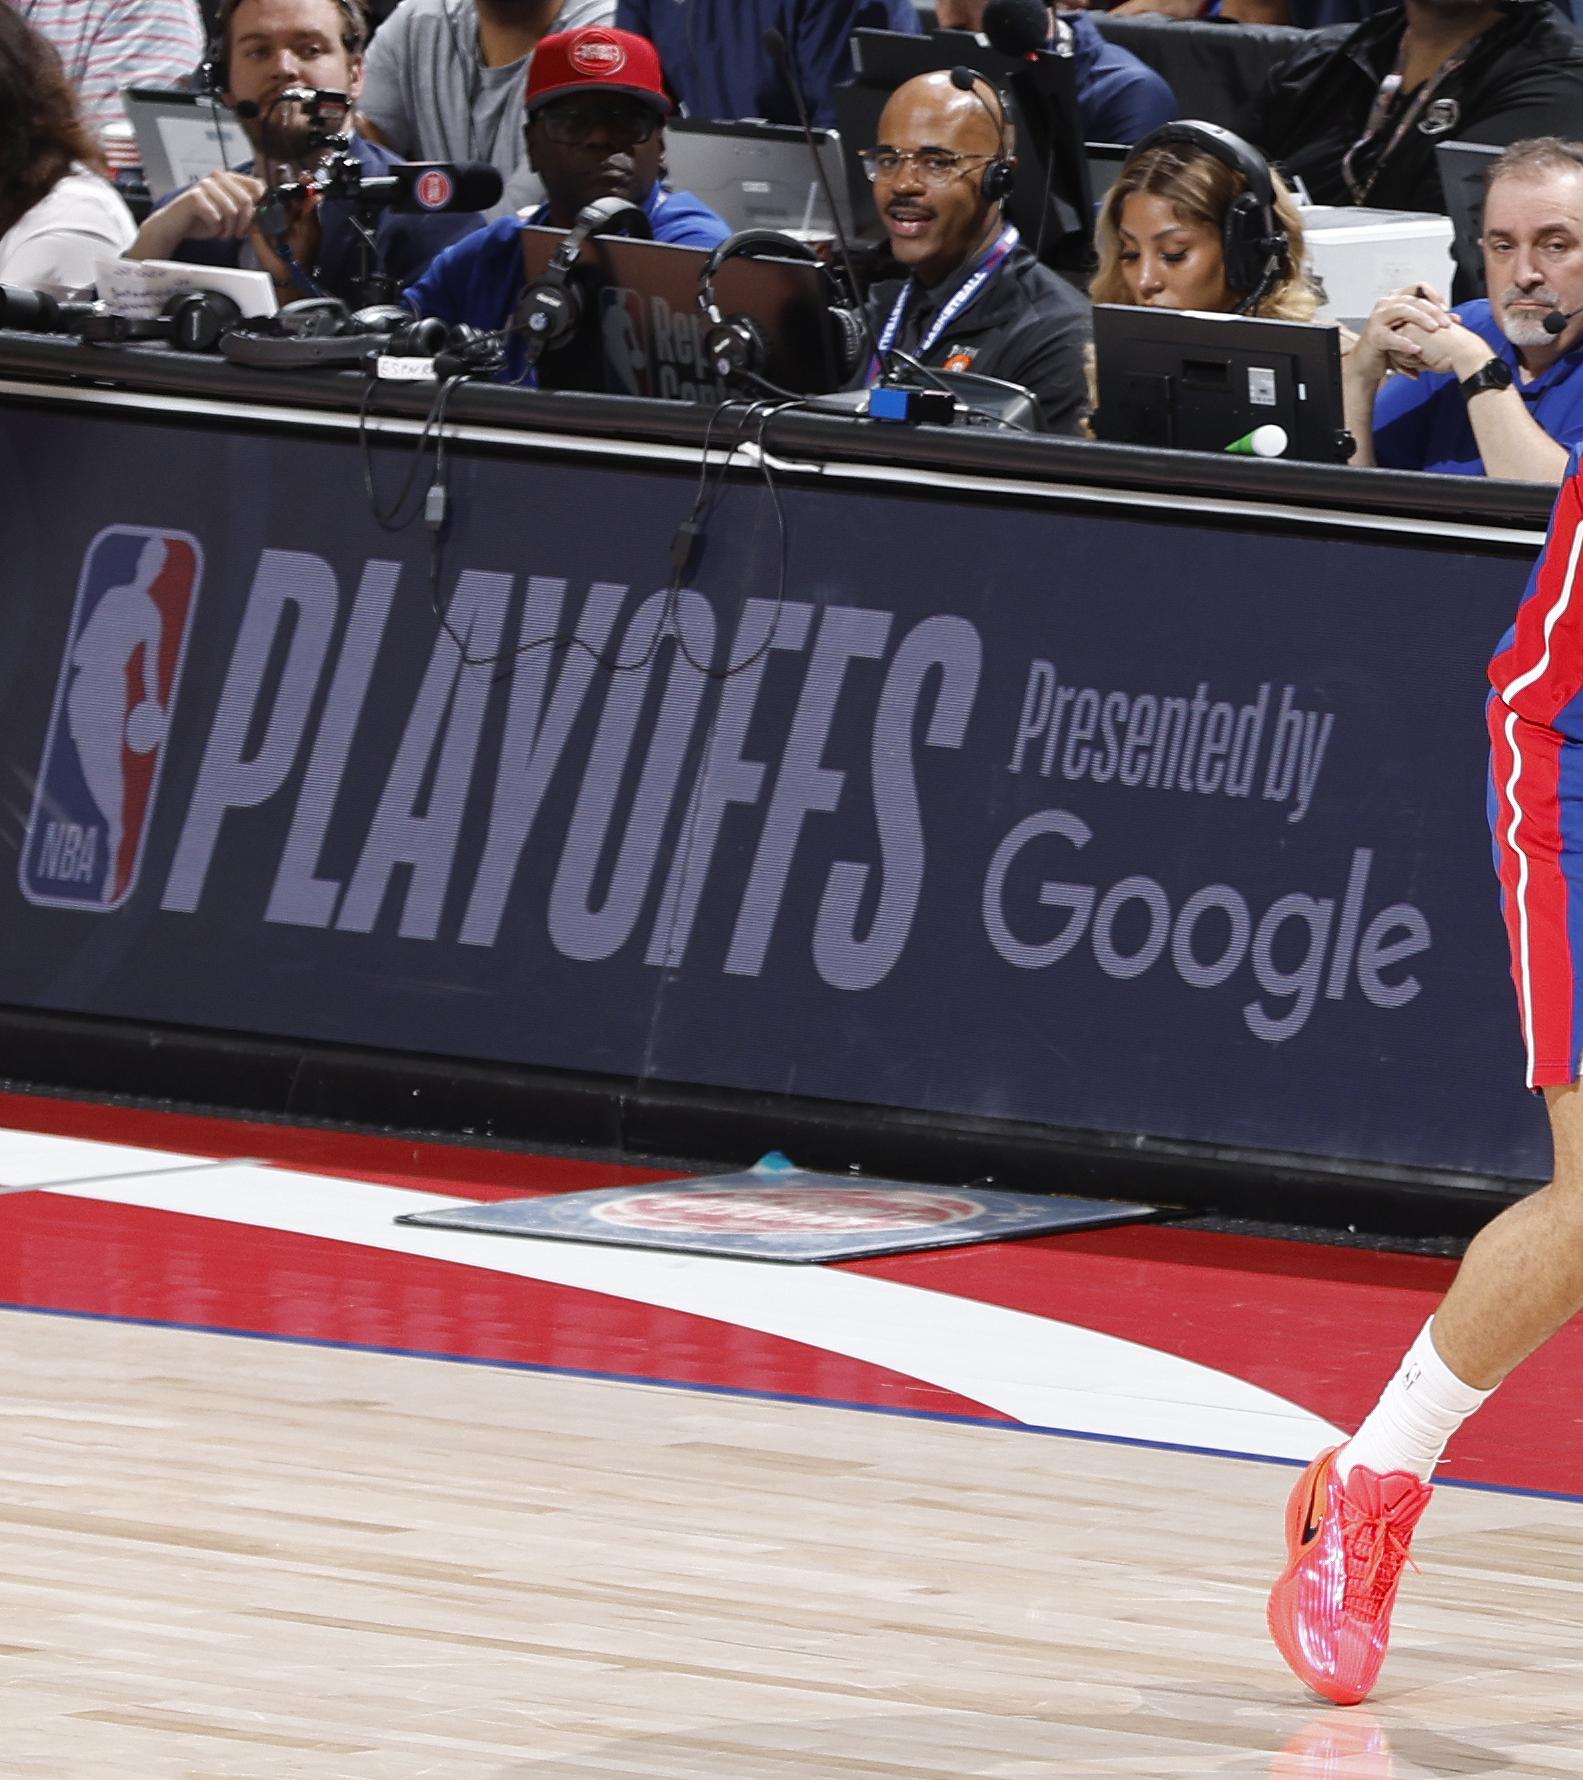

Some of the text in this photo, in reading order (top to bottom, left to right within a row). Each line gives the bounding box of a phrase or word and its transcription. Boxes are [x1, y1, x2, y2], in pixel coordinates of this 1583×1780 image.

[160, 547, 983, 992] PLAYOFFS
[1007, 657, 1335, 824] Presented by
[37, 821, 98, 884] NBA
[981, 808, 1432, 1043] Google
